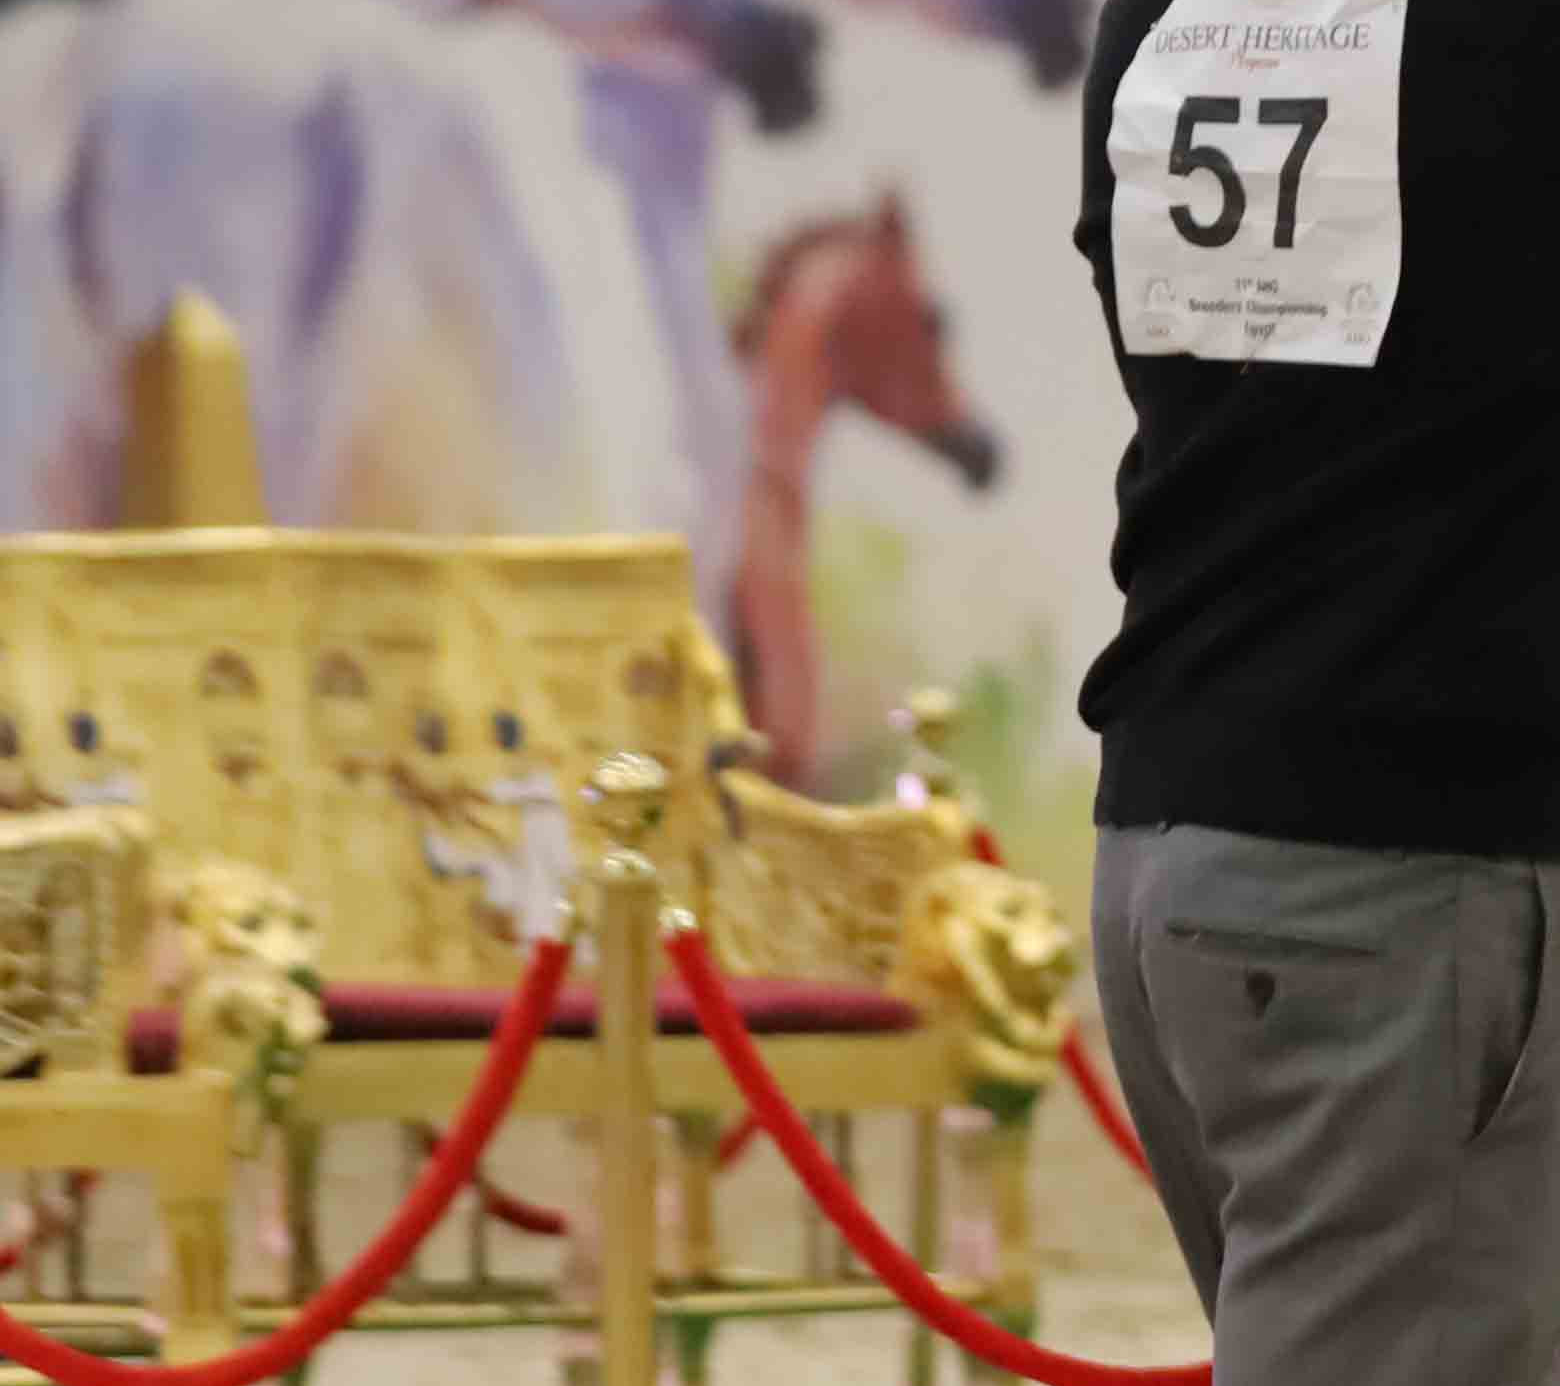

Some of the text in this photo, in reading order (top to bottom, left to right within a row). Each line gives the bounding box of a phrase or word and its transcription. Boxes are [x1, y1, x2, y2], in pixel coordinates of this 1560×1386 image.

[1154, 21, 1372, 54] DESERT HERITAGE
[1168, 96, 1329, 249] 57
